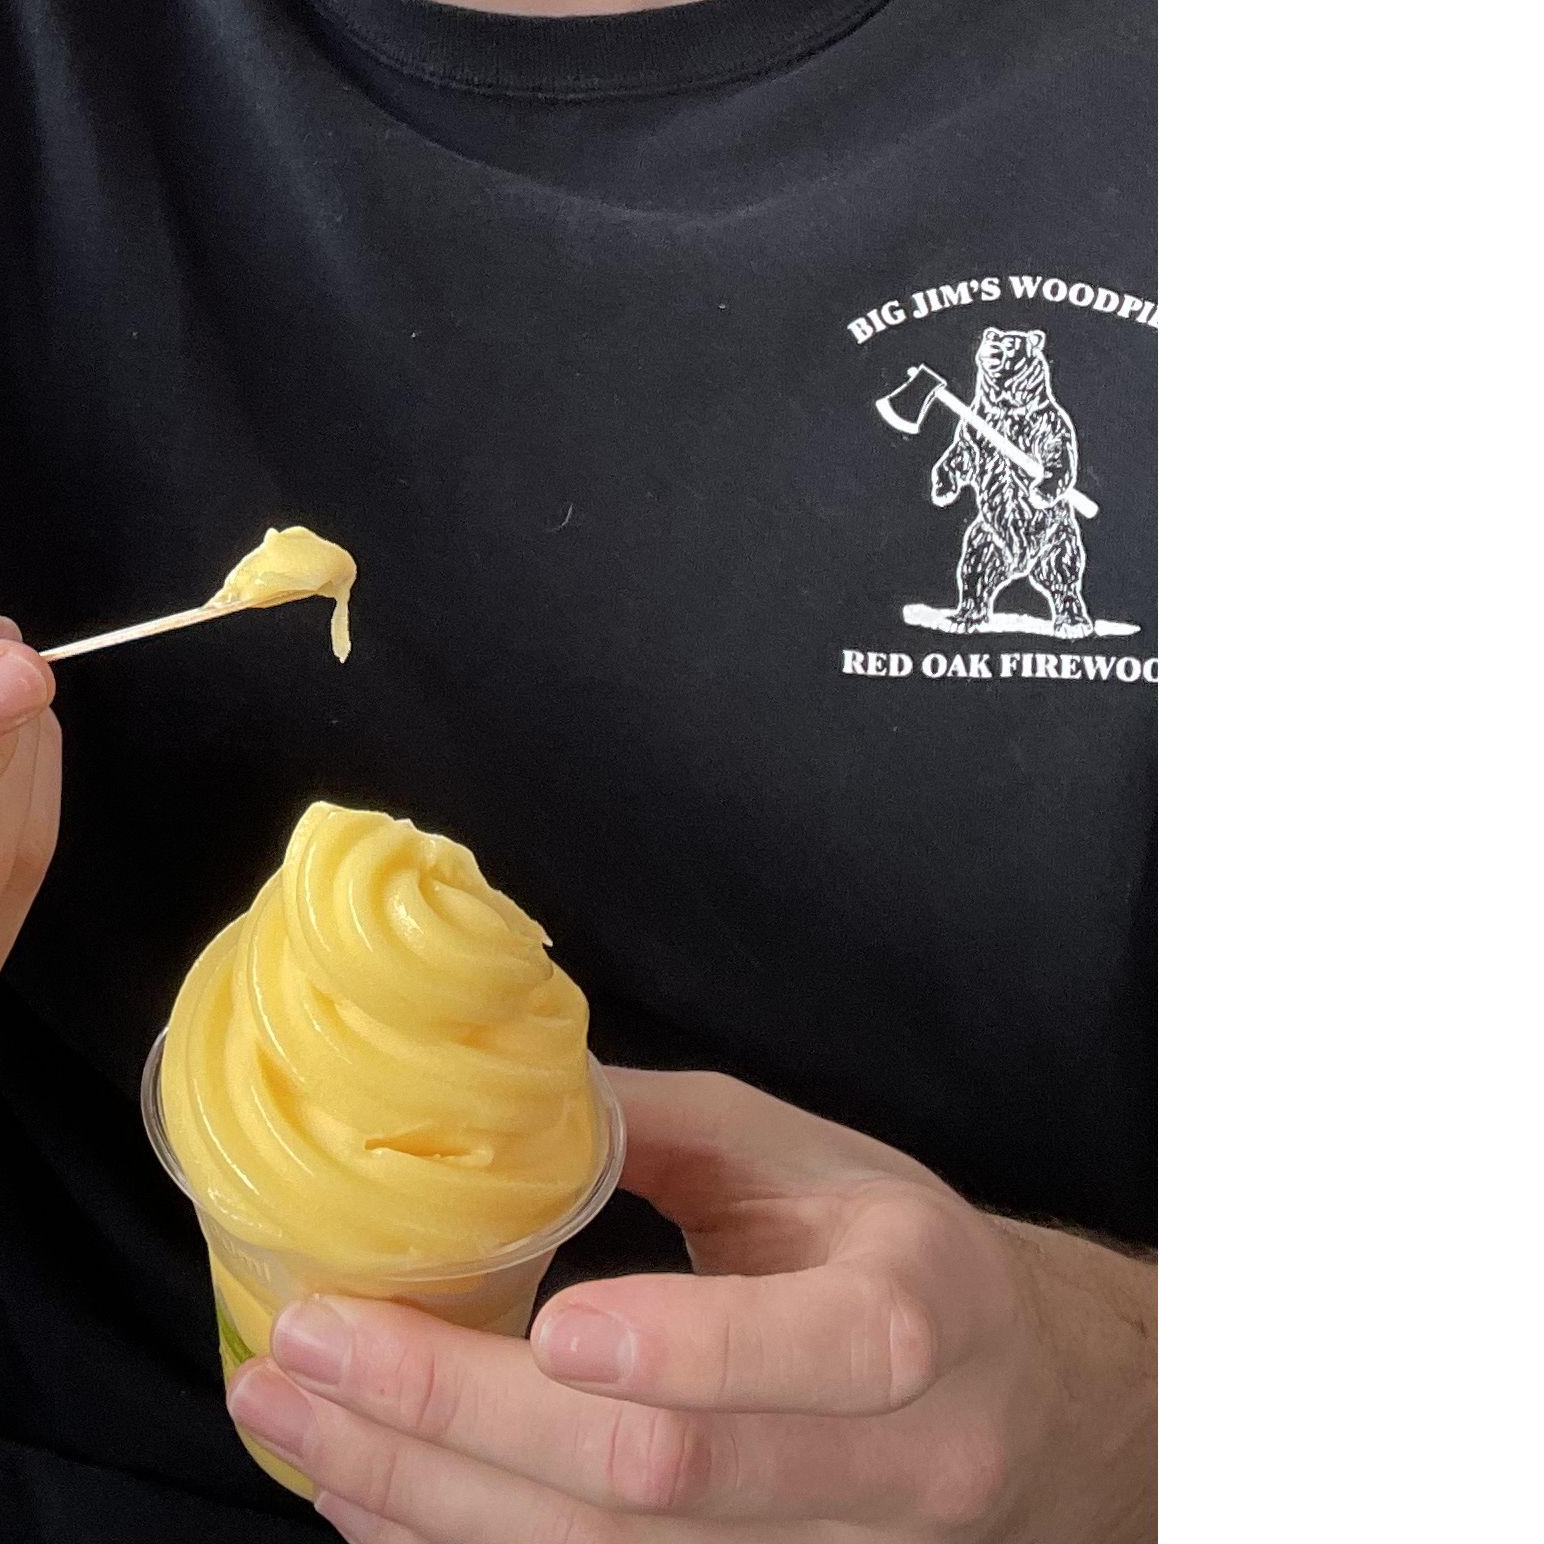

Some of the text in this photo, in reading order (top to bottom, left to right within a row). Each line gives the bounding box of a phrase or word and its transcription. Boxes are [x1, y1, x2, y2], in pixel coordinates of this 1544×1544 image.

[847, 300, 907, 345] BIG
[911, 277, 1002, 319] JIM'S
[842, 649, 914, 677] RED
[921, 653, 993, 678] OAK
